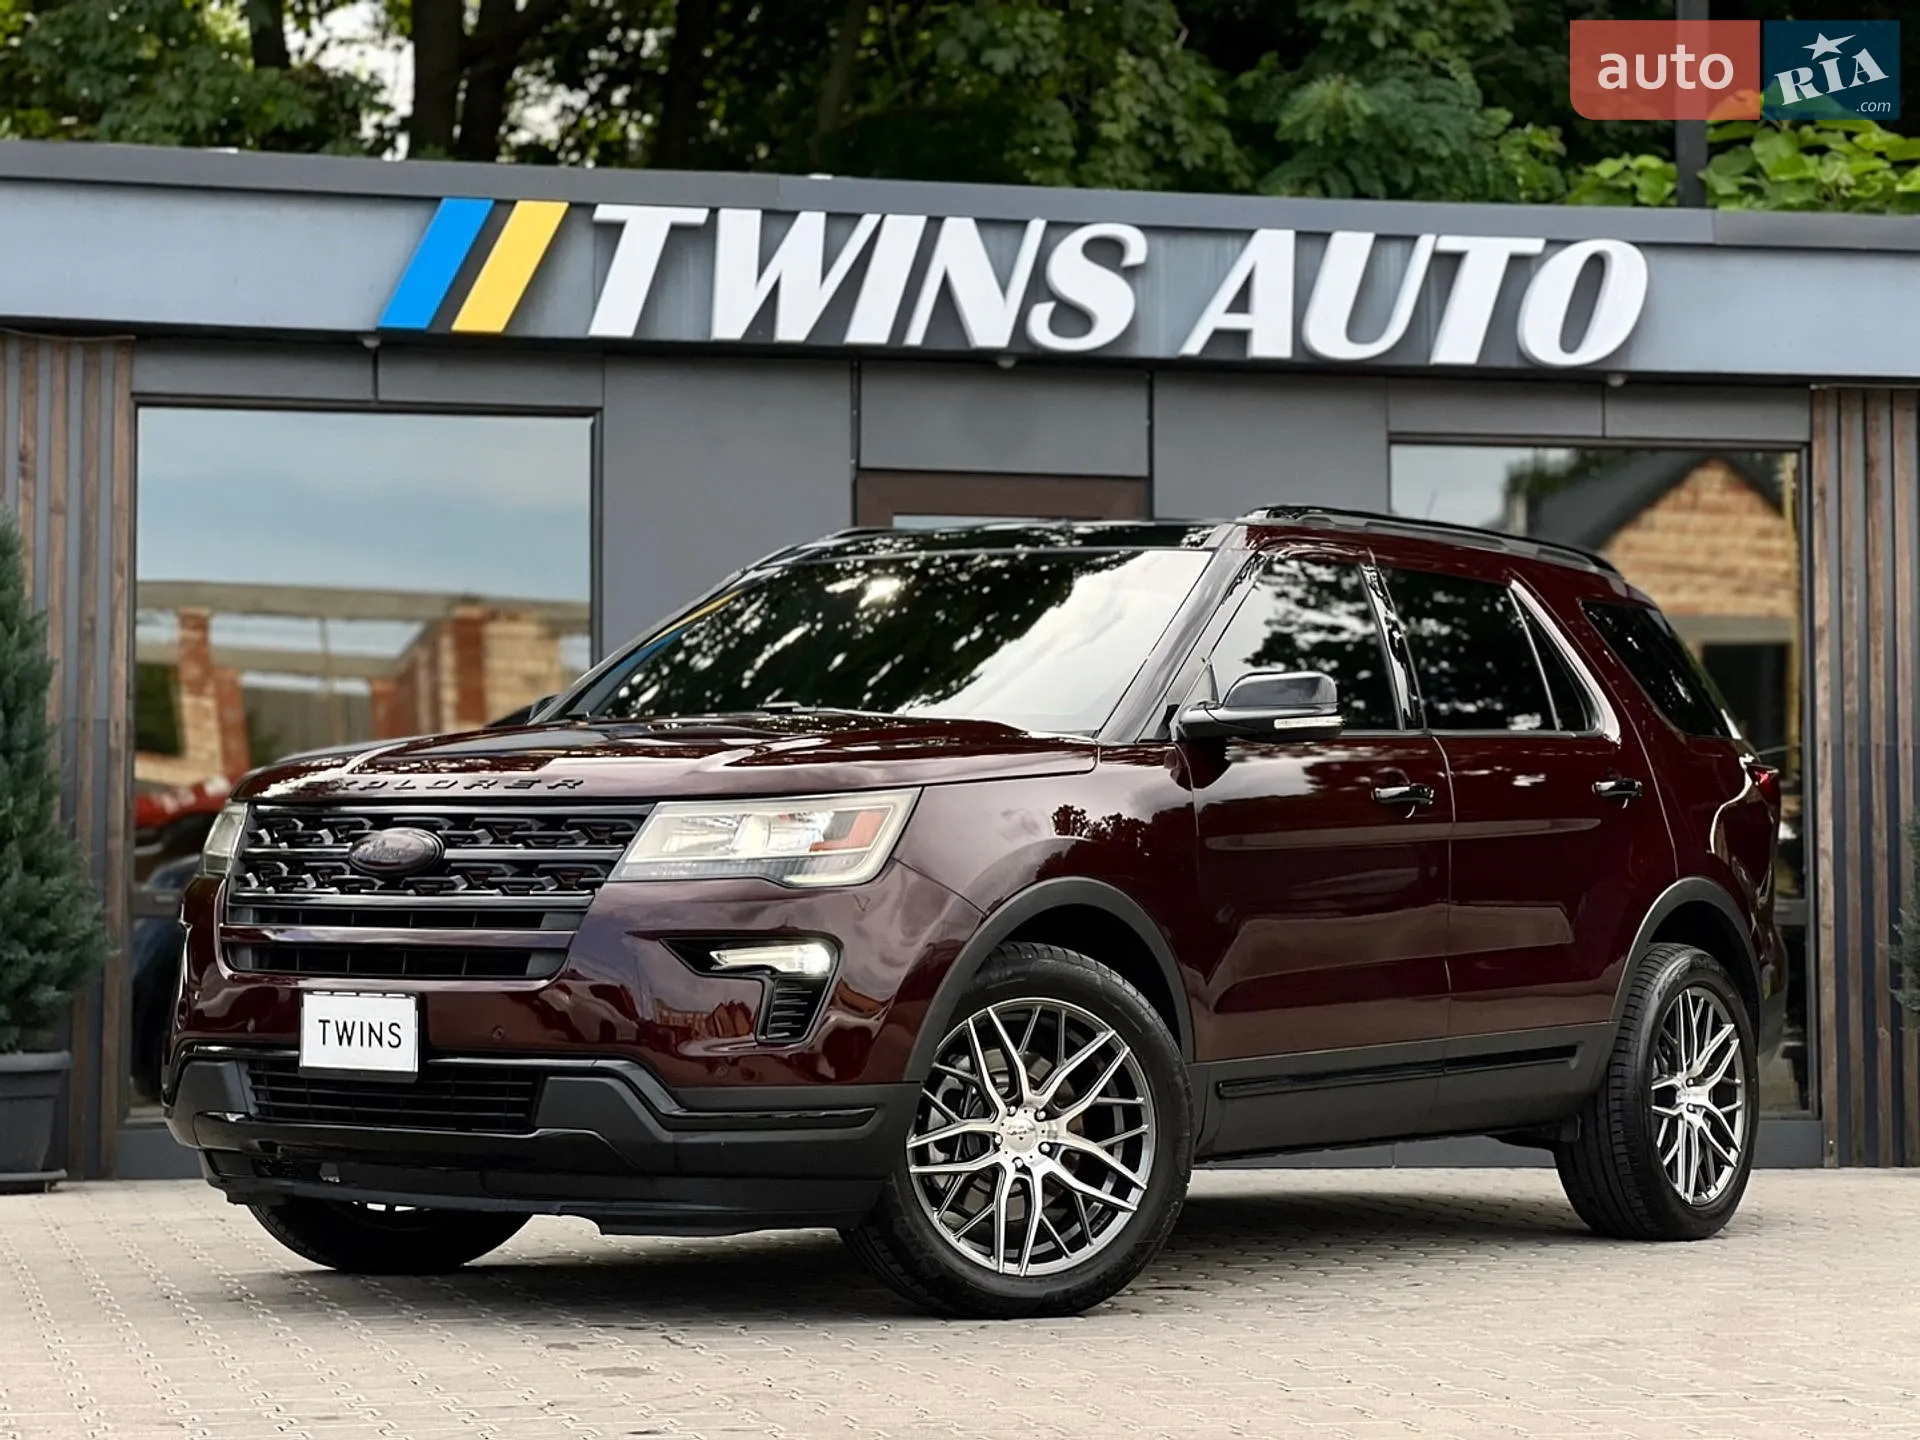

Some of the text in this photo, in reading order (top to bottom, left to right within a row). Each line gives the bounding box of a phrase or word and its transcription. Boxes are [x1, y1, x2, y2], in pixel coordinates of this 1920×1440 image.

[588, 204, 1648, 368] TWINS AUTO
[318, 1019, 402, 1048] TWINS
